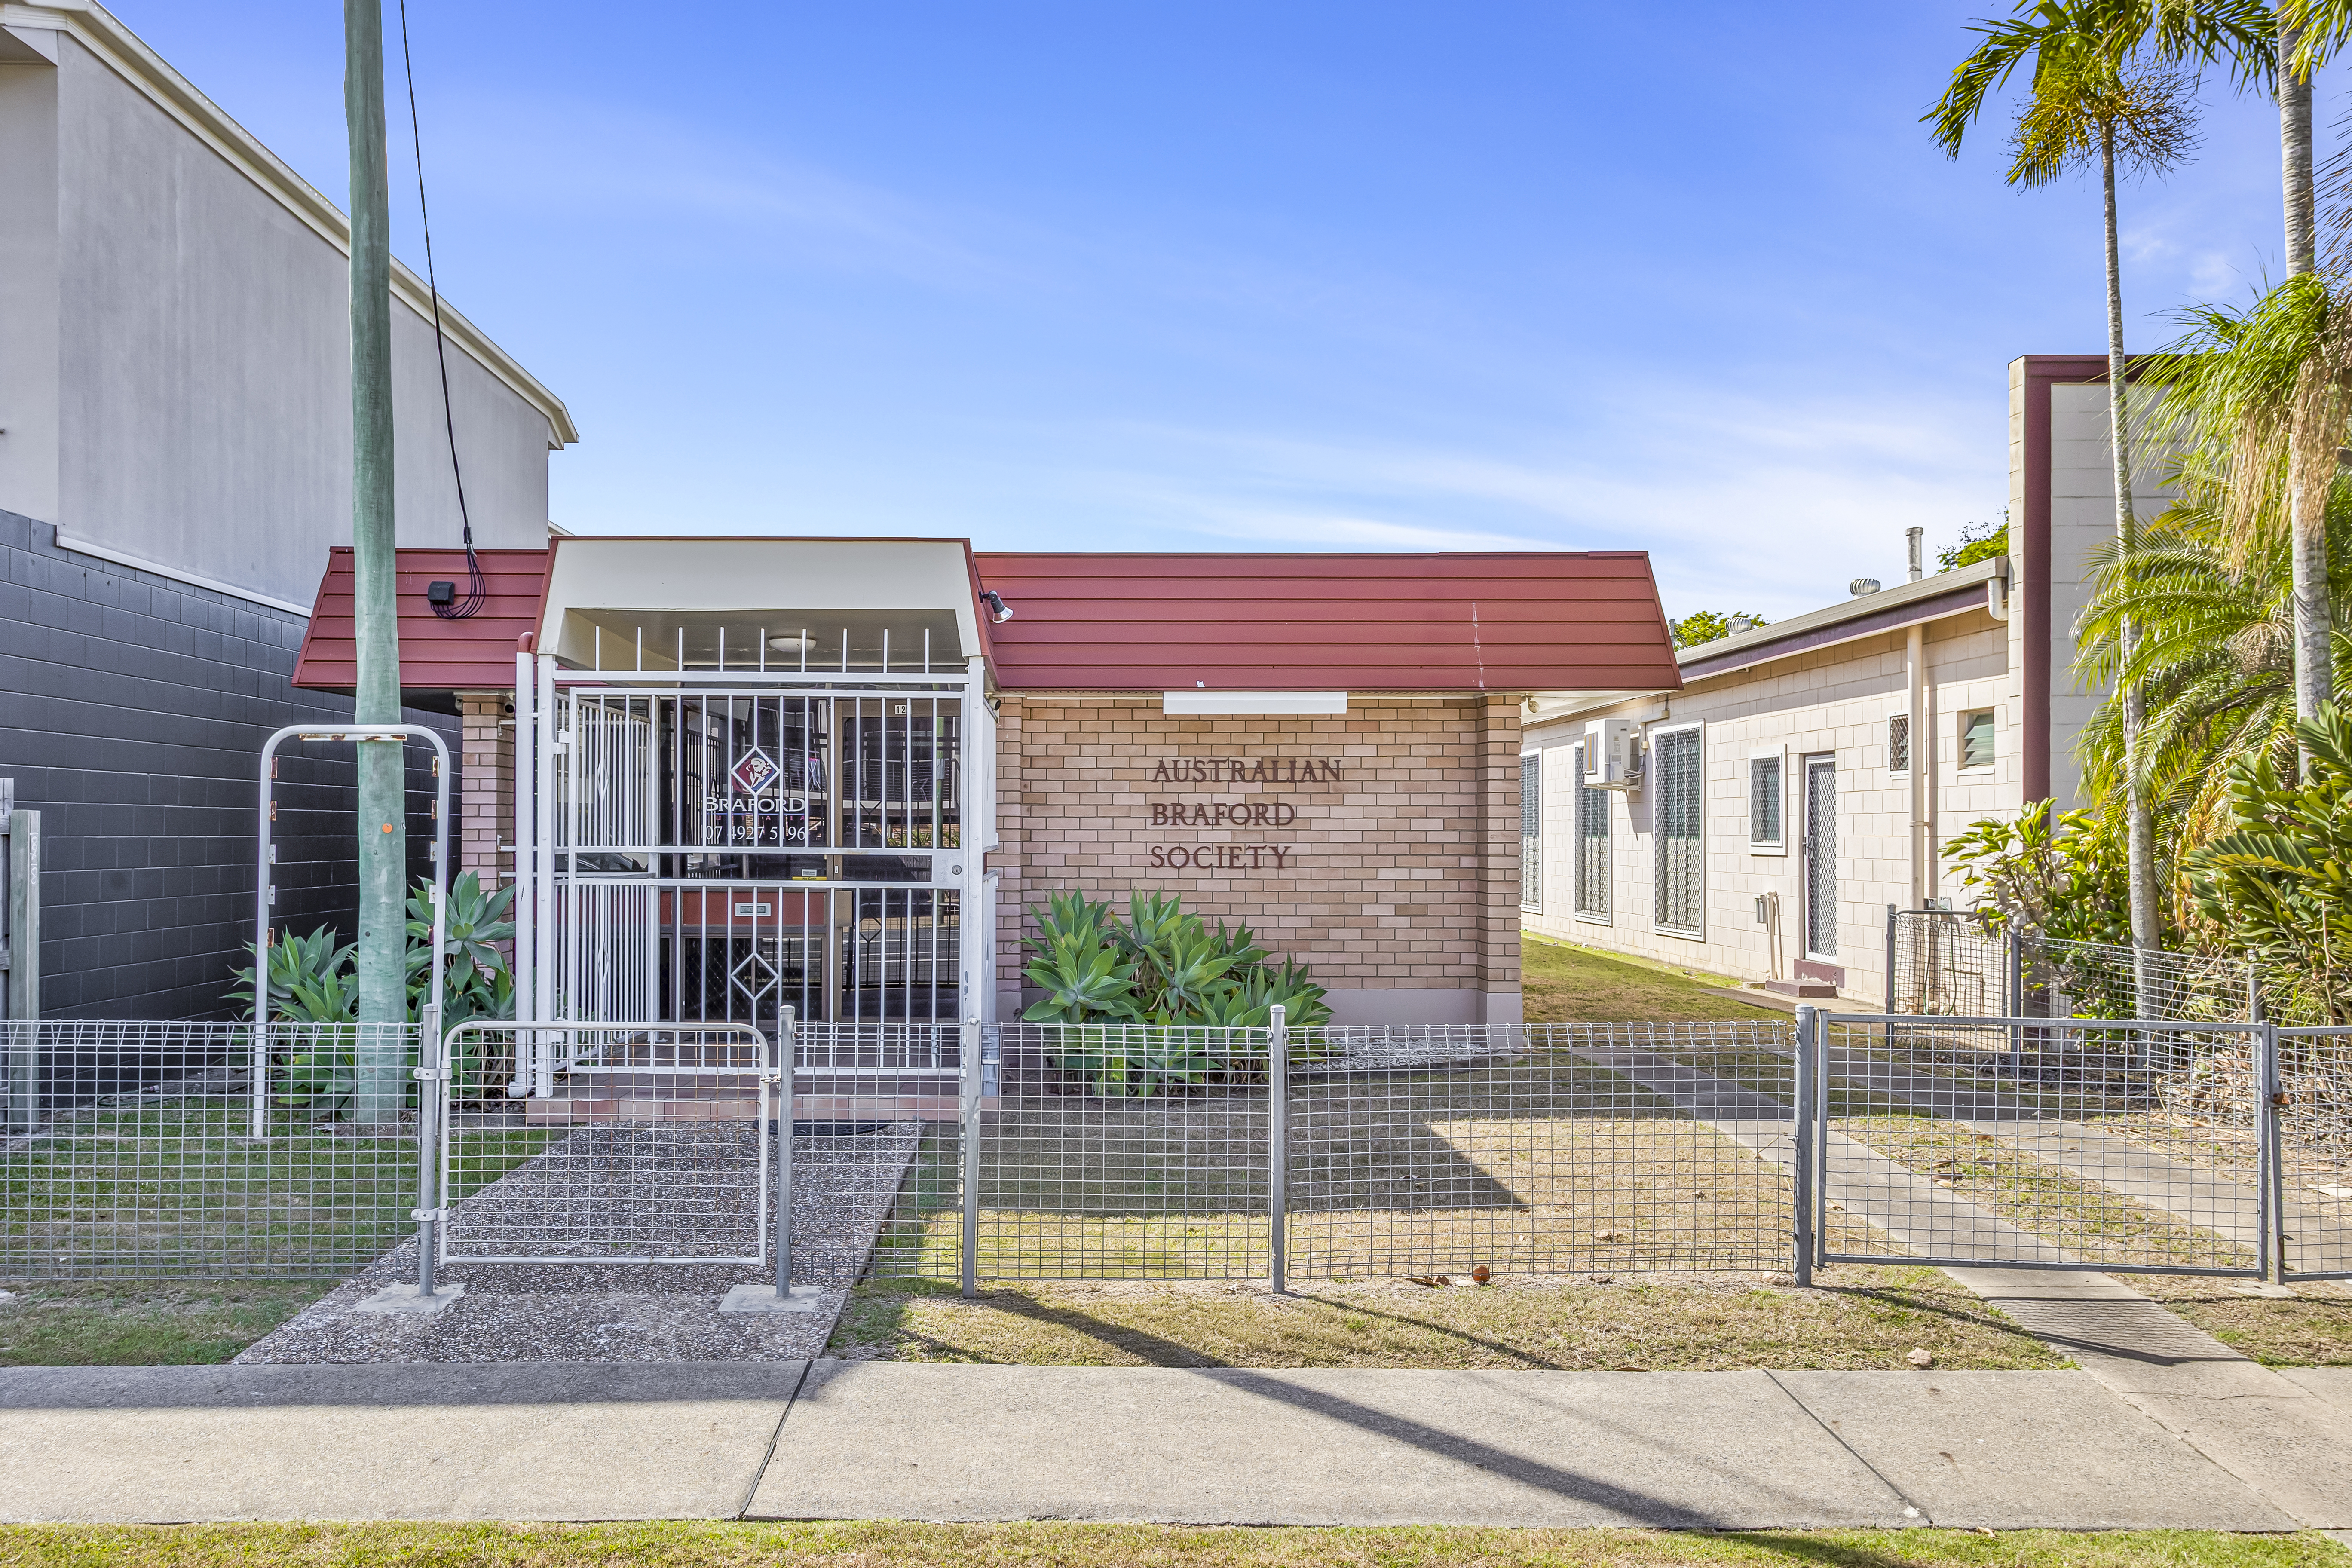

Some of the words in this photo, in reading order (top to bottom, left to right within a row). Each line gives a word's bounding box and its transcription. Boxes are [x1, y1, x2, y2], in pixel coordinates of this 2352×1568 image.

[1151, 758, 1342, 783] AUSTRALIAN
[706, 796, 805, 812] BRAFORD
[1151, 802, 1295, 826] BRAFORD
[706, 826, 723, 839] 07
[728, 825, 764, 840] 4927
[1151, 845, 1292, 869] SOCIETY
